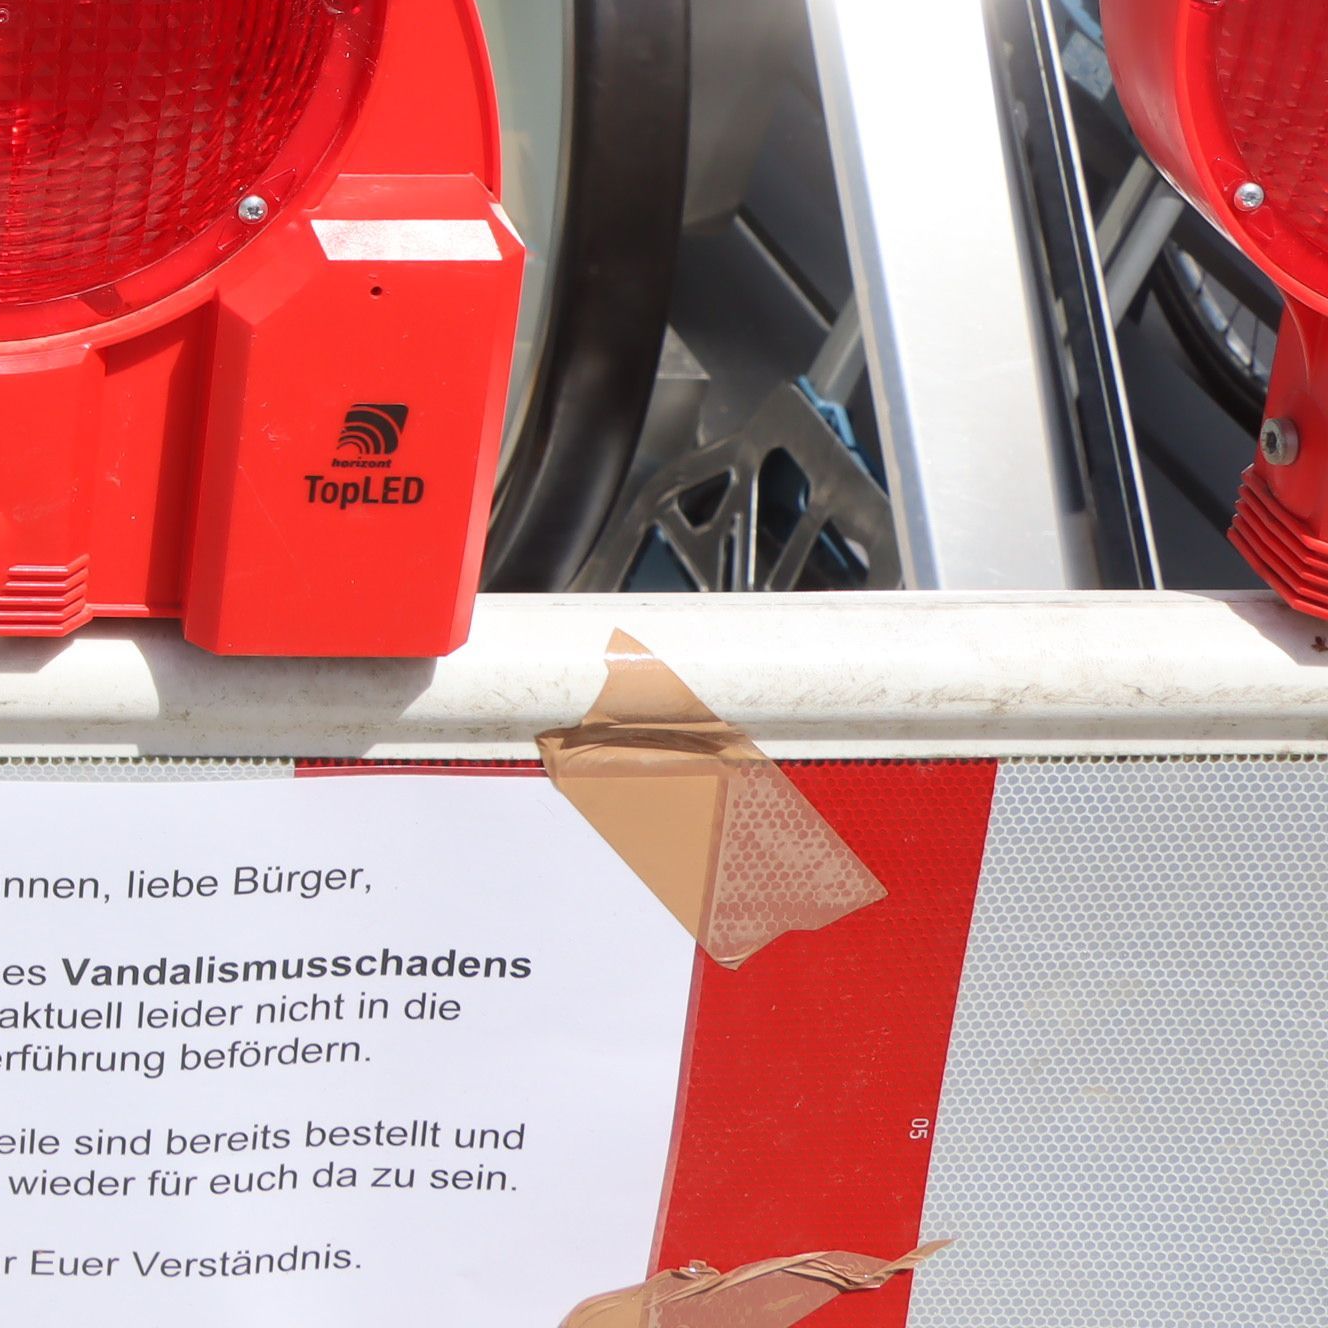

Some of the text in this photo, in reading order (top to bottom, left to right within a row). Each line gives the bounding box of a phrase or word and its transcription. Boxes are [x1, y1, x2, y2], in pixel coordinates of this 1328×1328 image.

[331, 456, 392, 469] horizont
[304, 474, 425, 510] TopLED
[126, 869, 219, 899] liebe
[233, 863, 372, 899] Bürger,
[61, 948, 532, 987] Vandalismusschadens
[137, 999, 244, 1029] leider
[256, 993, 345, 1024] nicht
[358, 991, 389, 1019] in
[404, 992, 461, 1021] die
[180, 1037, 371, 1071] befördern.
[74, 1128, 152, 1156] sind
[166, 1124, 291, 1156] bereits
[305, 1119, 441, 1148] bestellt
[455, 1123, 525, 1150] und
[908, 1117, 931, 1140] 05
[8, 1169, 136, 1197] wieder
[147, 1169, 198, 1197] für
[209, 1163, 298, 1195] euch
[312, 1161, 357, 1188] da
[370, 1167, 415, 1188] zu
[429, 1163, 517, 1191] sein.
[30, 1250, 120, 1277] Euer
[132, 1243, 361, 1278] Verständnis.
